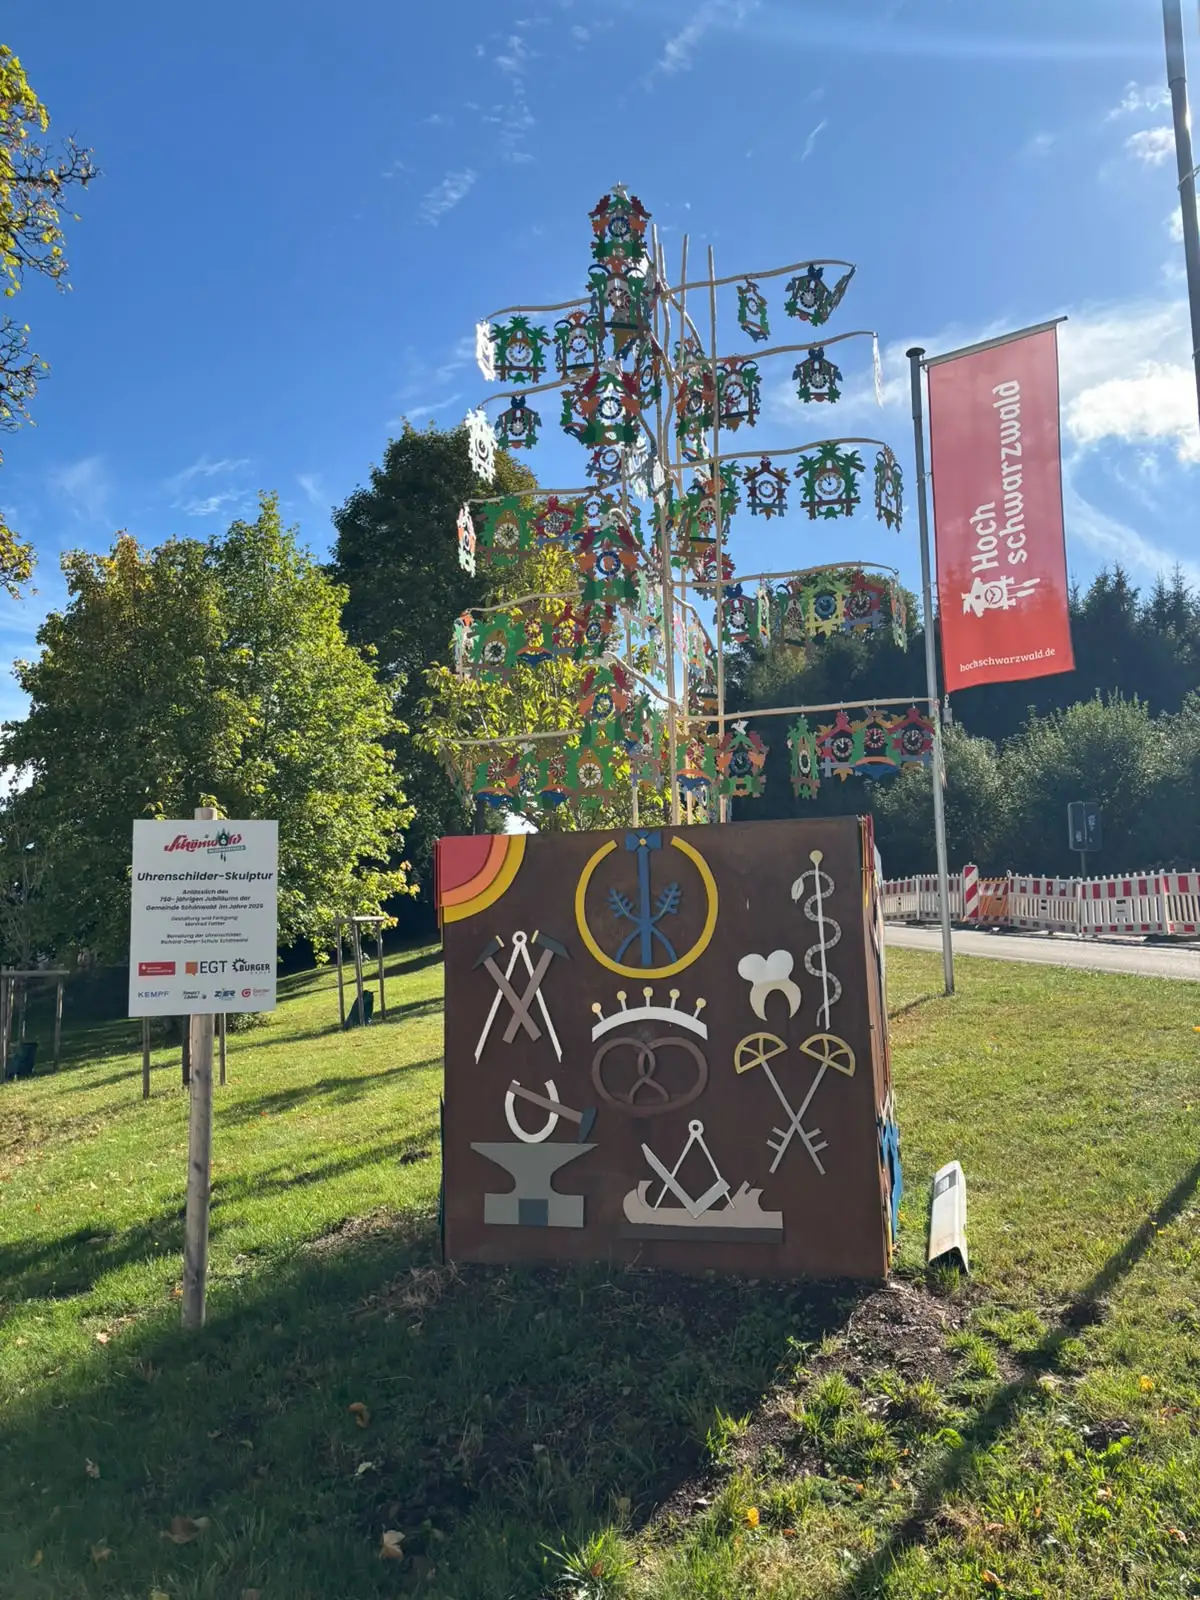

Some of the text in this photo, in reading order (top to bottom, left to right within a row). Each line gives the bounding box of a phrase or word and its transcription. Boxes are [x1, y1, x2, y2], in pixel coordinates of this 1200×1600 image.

[992, 380, 1028, 565] schwarzwald
[969, 501, 999, 574] Hoch
[959, 647, 1056, 673] hochschwarzwald.de
[137, 871, 274, 883] Uhrenschilder-Skulptur
[200, 960, 228, 974] EGT
[239, 963, 270, 971] BURGER
